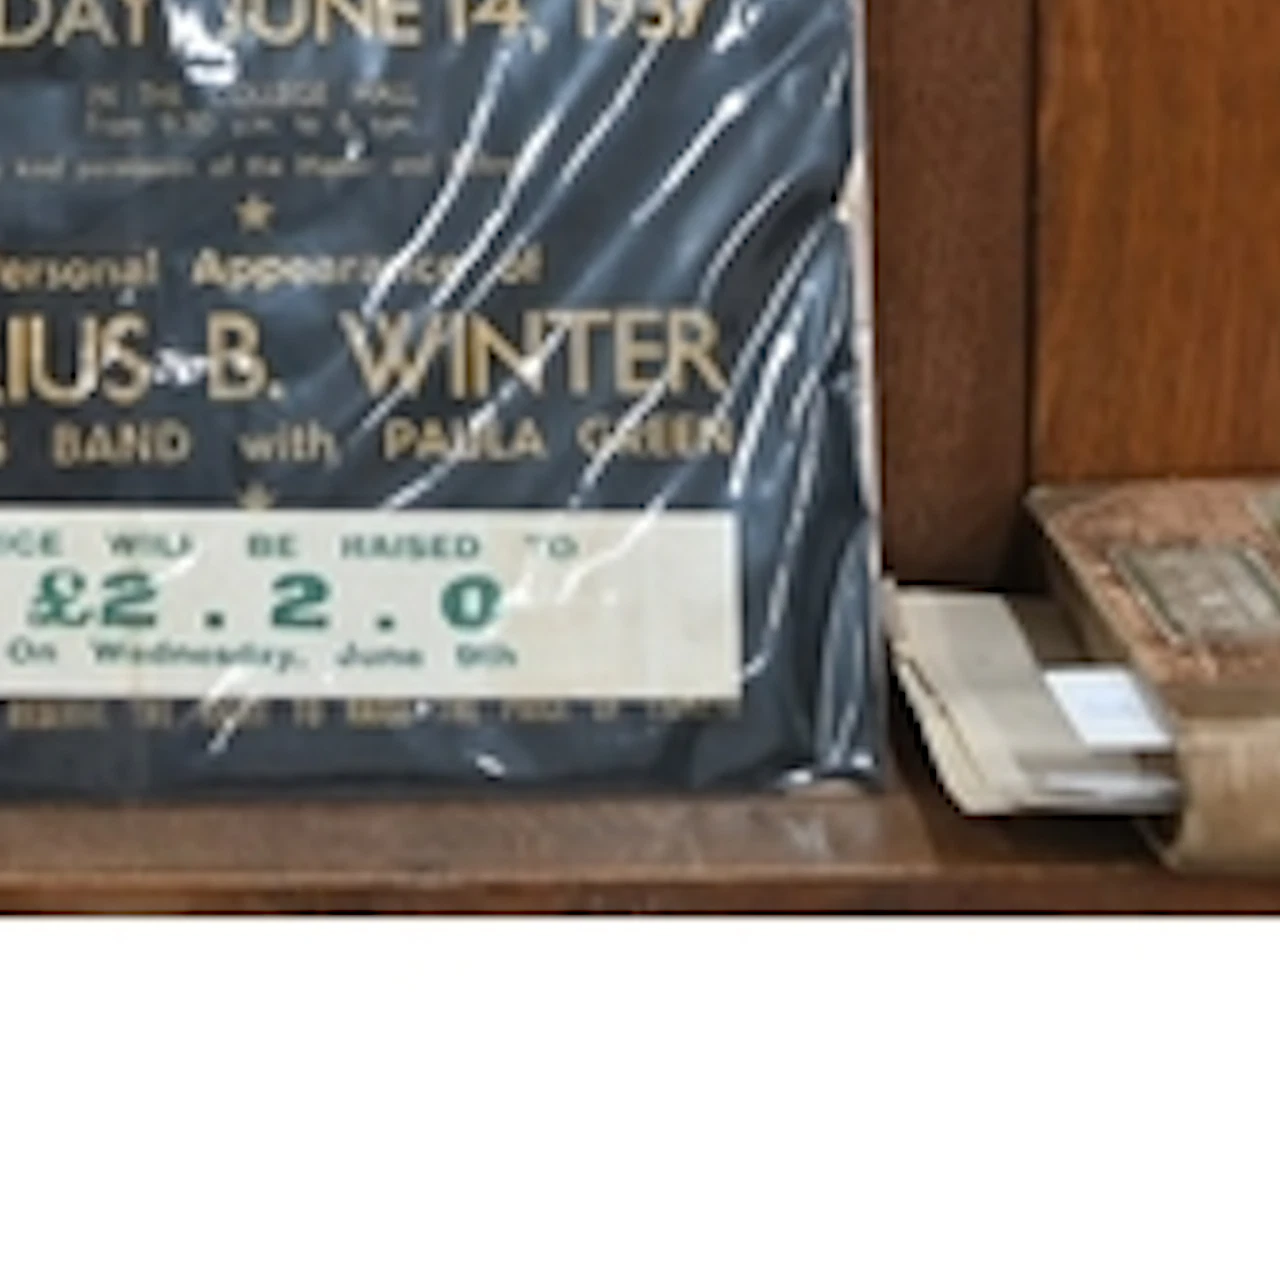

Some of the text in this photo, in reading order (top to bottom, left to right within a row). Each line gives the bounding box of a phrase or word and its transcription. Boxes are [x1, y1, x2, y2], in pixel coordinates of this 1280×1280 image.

[337, 307, 730, 402] WINTER
[51, 417, 192, 469] BAND
[239, 418, 333, 464] with
[246, 529, 298, 559] BE
[339, 532, 482, 560] RAISED
[7, 637, 58, 666] On
